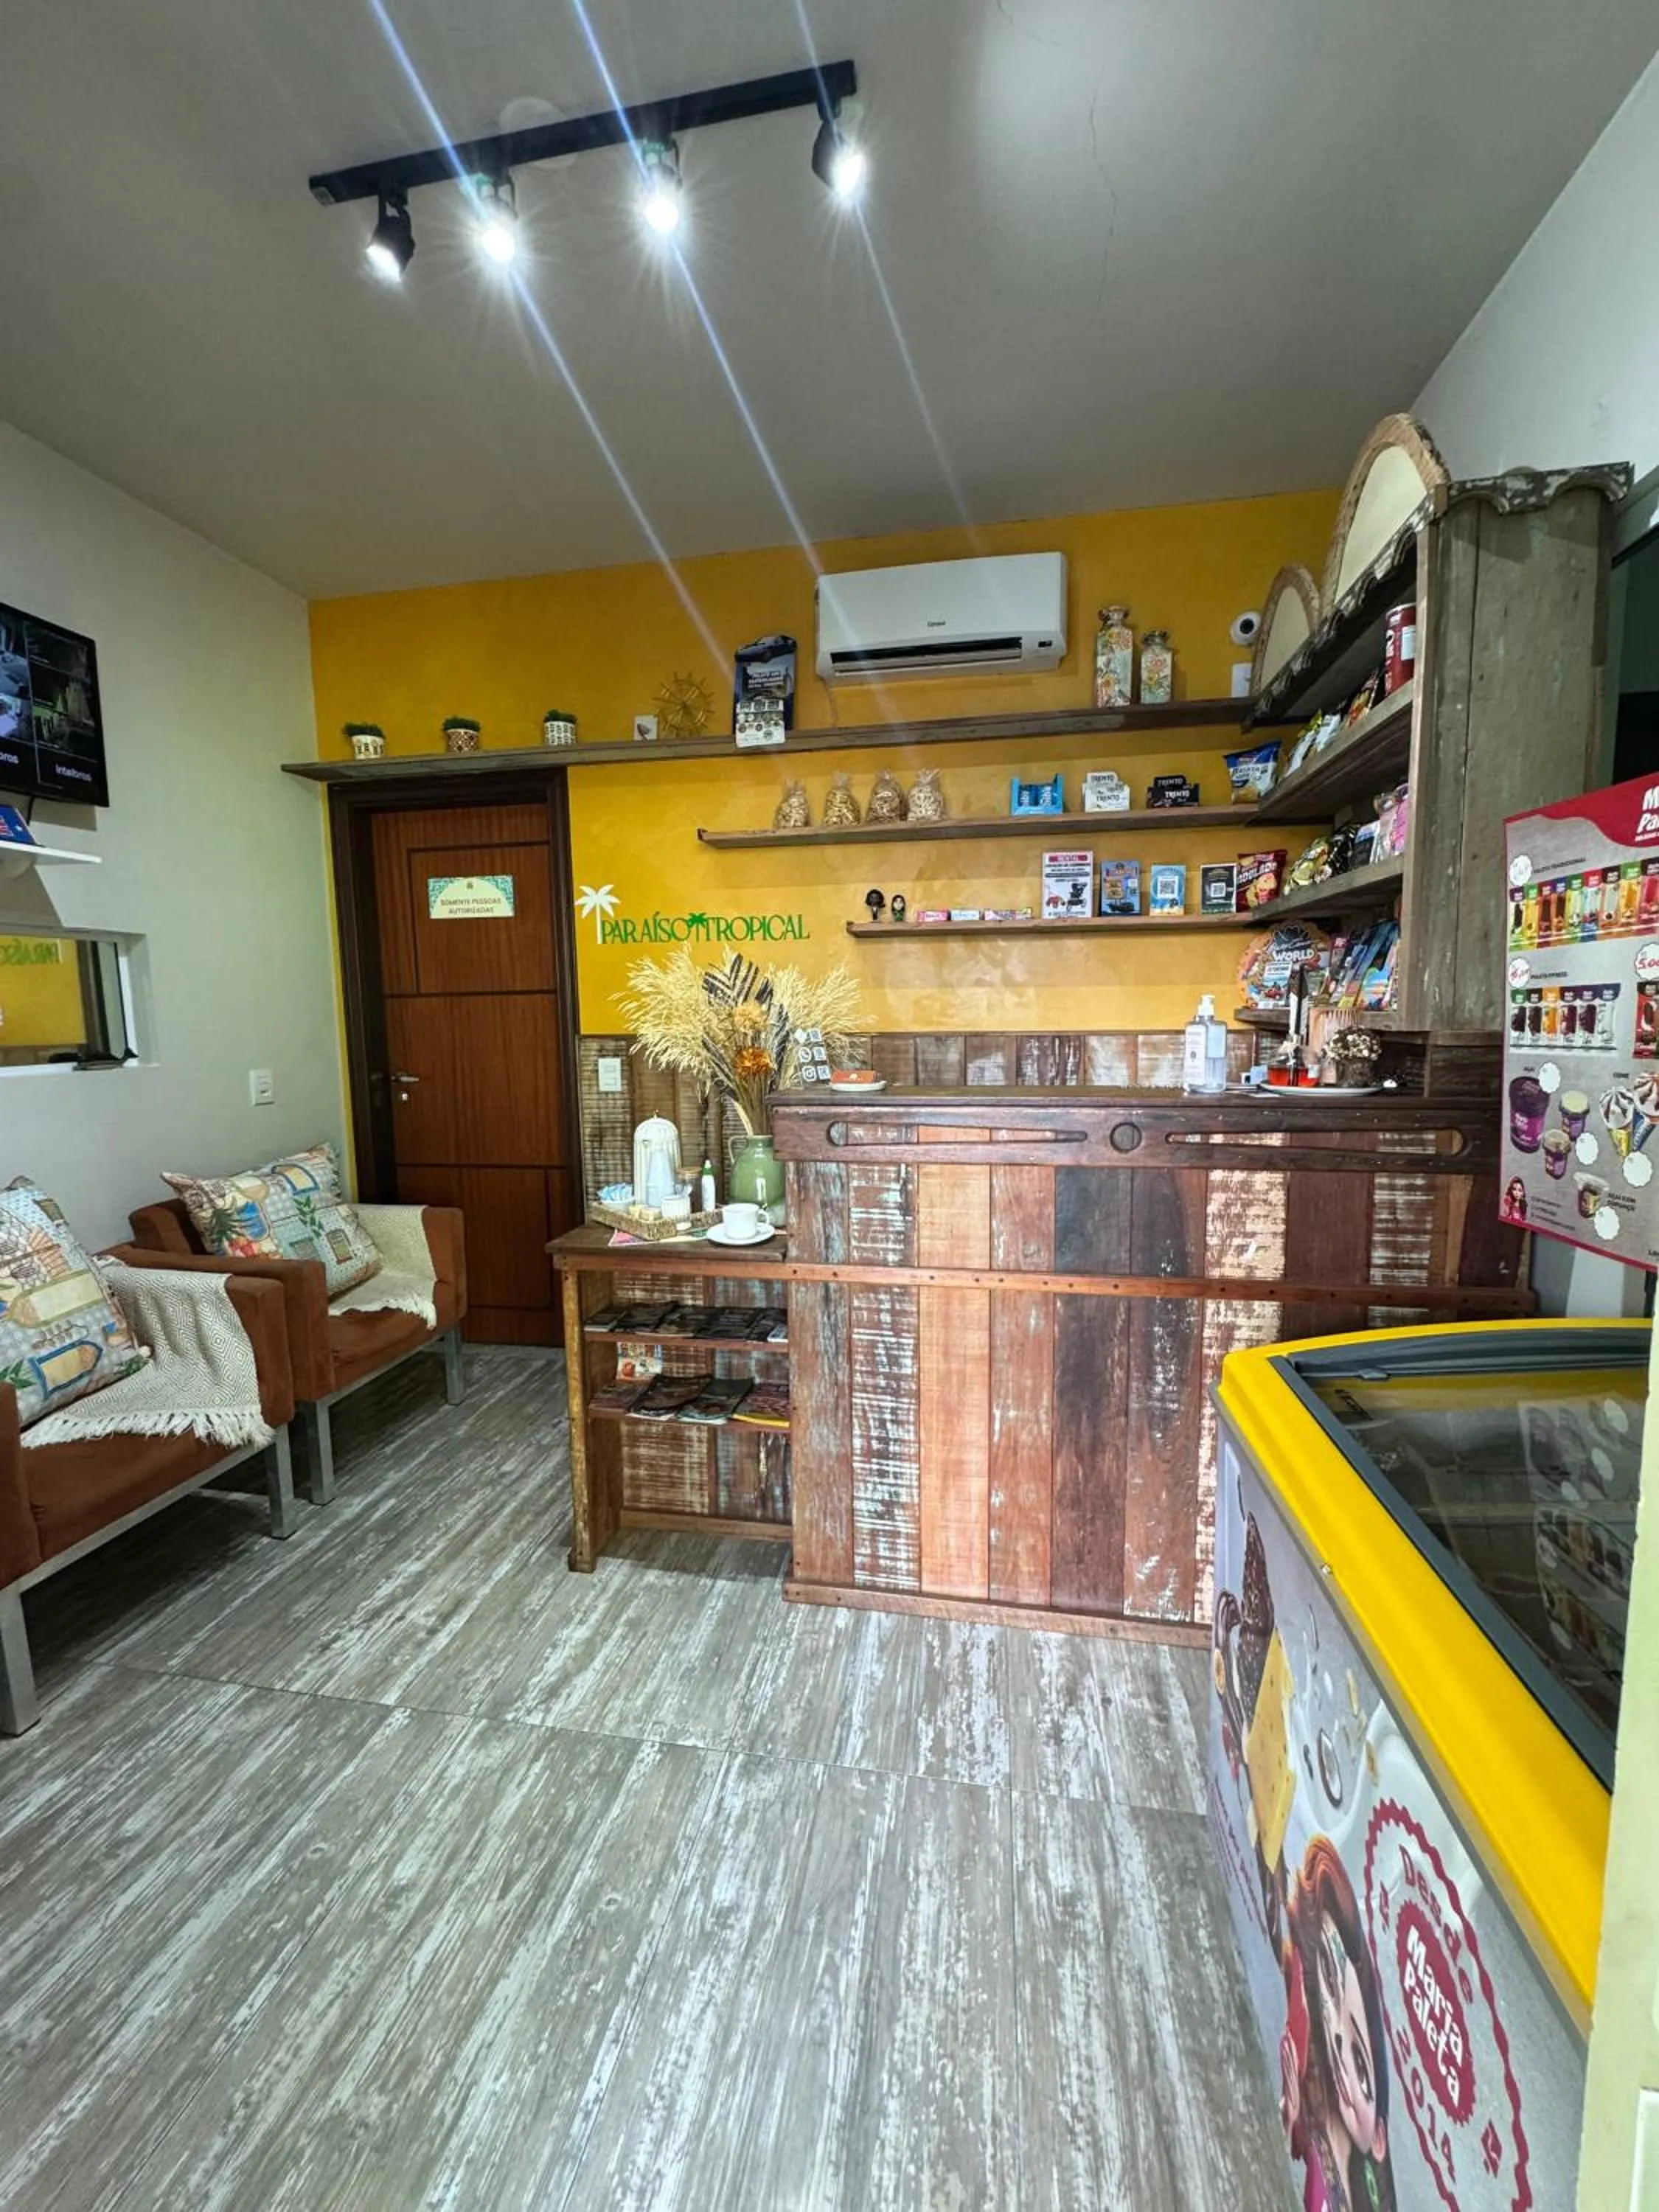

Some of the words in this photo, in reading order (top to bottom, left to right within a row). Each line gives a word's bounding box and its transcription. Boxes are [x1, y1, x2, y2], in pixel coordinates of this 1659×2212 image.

[1157, 778, 1183, 787] TRENTO
[1164, 790, 1190, 799] TRENTO
[601, 911, 691, 945] PARAÍSO
[706, 914, 810, 942] TROPICAL
[1272, 947, 1315, 962] WORLD
[1406, 1924, 1463, 2067] Maria
[1402, 1958, 1461, 2107] Paleta
[1396, 2026, 1457, 2183] 2019
